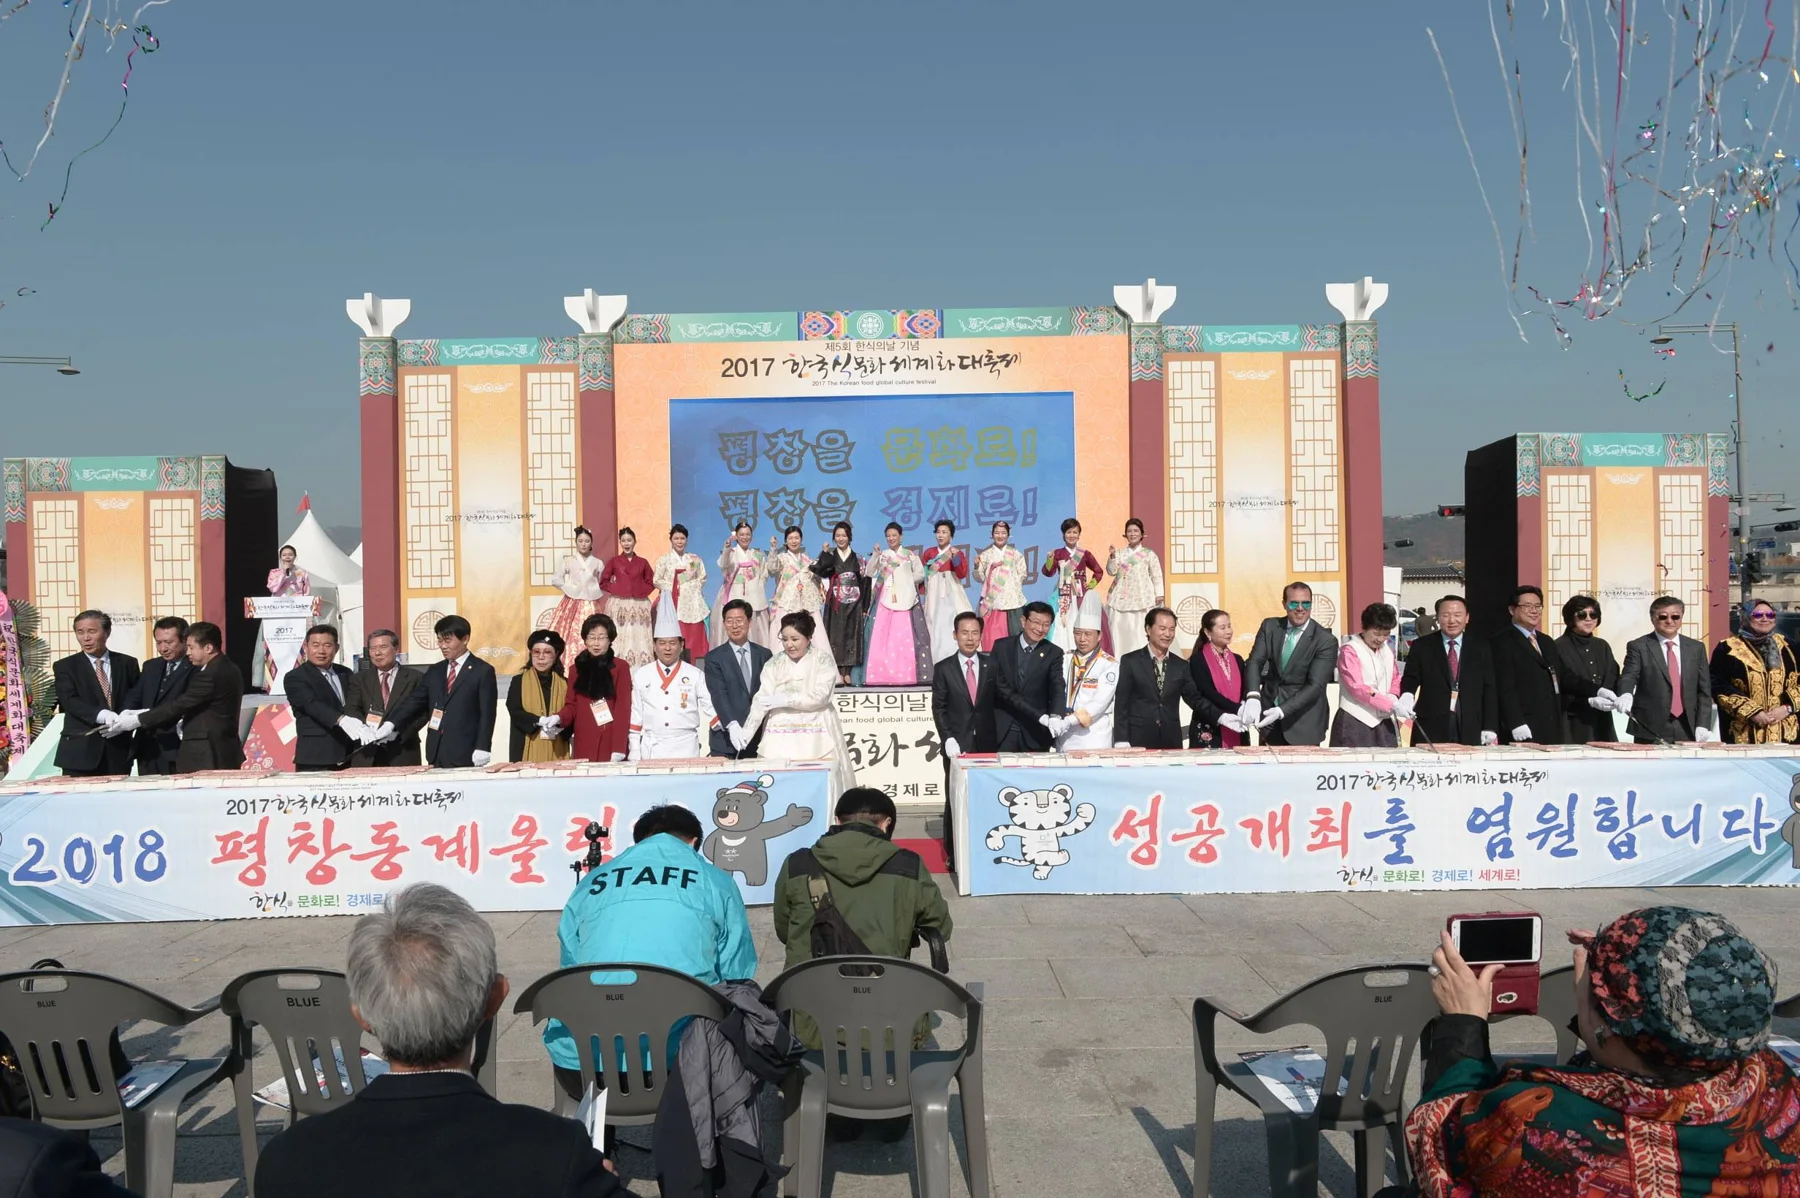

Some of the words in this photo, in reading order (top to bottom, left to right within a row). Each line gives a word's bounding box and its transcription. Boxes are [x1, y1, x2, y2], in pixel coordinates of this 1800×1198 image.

[825, 341, 851, 352] 제5회
[900, 340, 920, 351] 기념
[721, 357, 775, 378] 2017
[876, 379, 893, 387] global
[856, 716, 875, 724] food
[877, 715, 904, 724] global
[1316, 774, 1360, 791] 2017
[226, 798, 270, 815] 2017
[13, 829, 167, 884] 2018
[589, 866, 699, 895] STAFF
[1382, 869, 1425, 883] 문화로!
[1431, 868, 1473, 883] 경제로!
[1478, 868, 1521, 882] 세계로!
[297, 894, 340, 907] 문화로!
[853, 986, 872, 994] BLUE
[286, 996, 321, 1007] BLUE
[605, 993, 624, 1001] BLUE
[1374, 995, 1393, 1003] BLUE
[36, 1000, 57, 1008] BLUE
